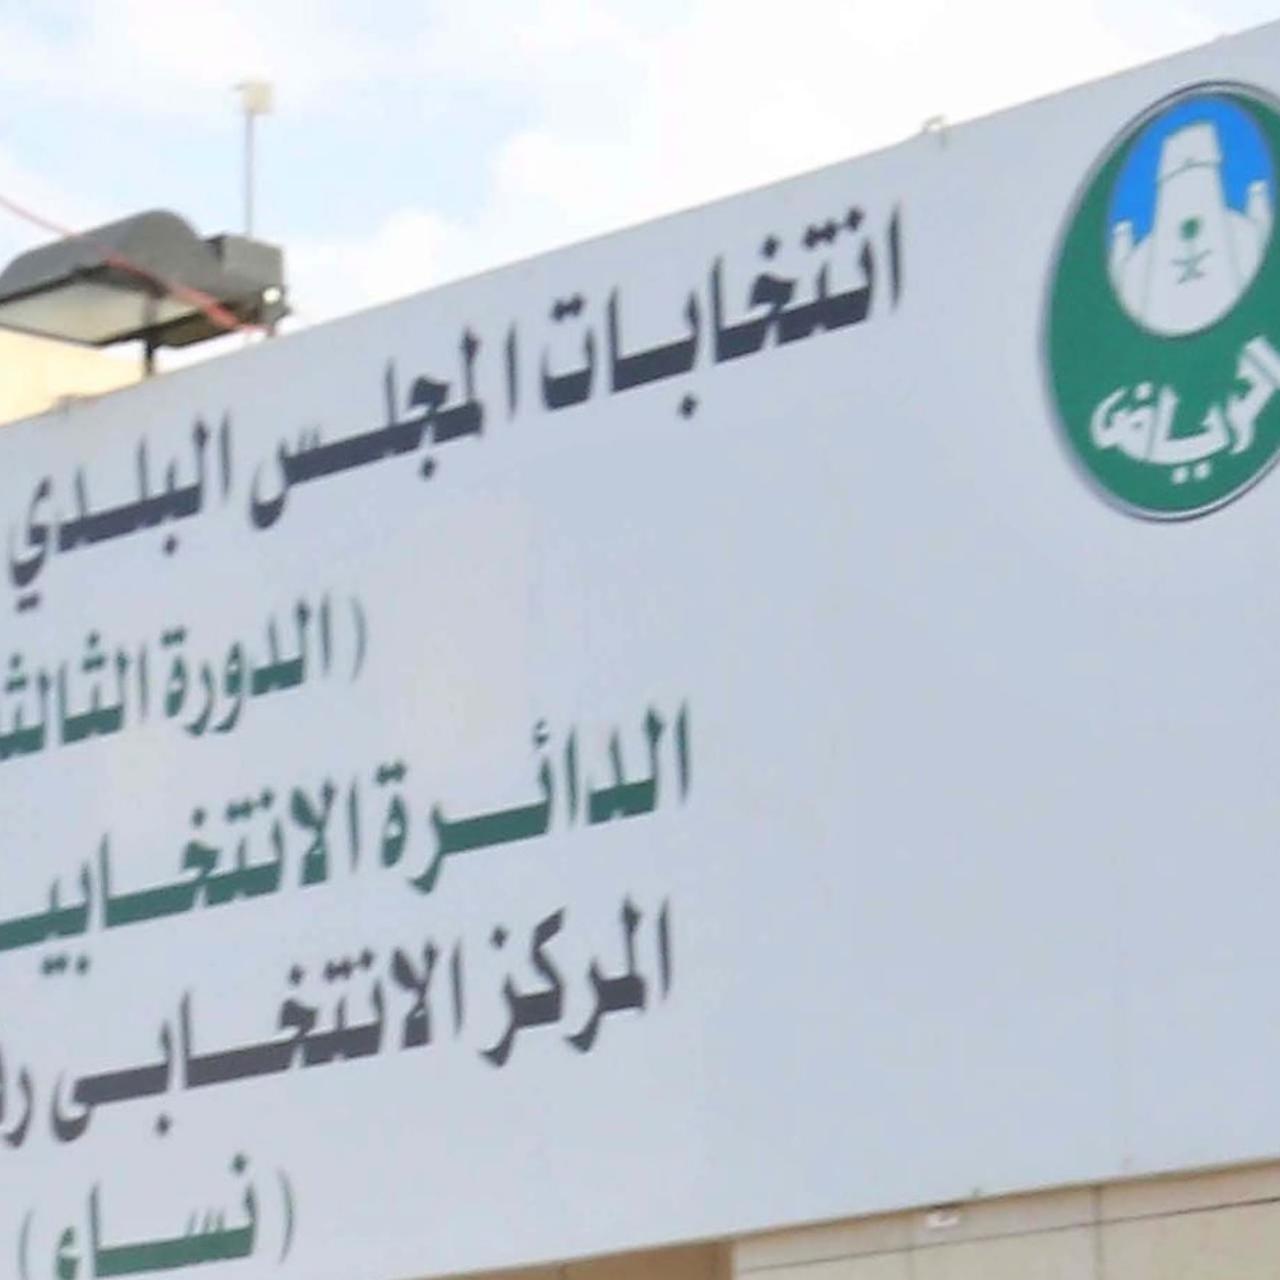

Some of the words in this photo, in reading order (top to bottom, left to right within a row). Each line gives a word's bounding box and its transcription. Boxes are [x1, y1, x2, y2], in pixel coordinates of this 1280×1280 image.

[541, 205, 903, 417] انتخابات
[8, 409, 232, 615] البلدي
[249, 326, 519, 531] المجلس
[0, 630, 148, 763] الثالث
[375, 698, 692, 894] الدائرة
[0, 777, 360, 977] الانتخابي
[478, 893, 674, 1069] المركز
